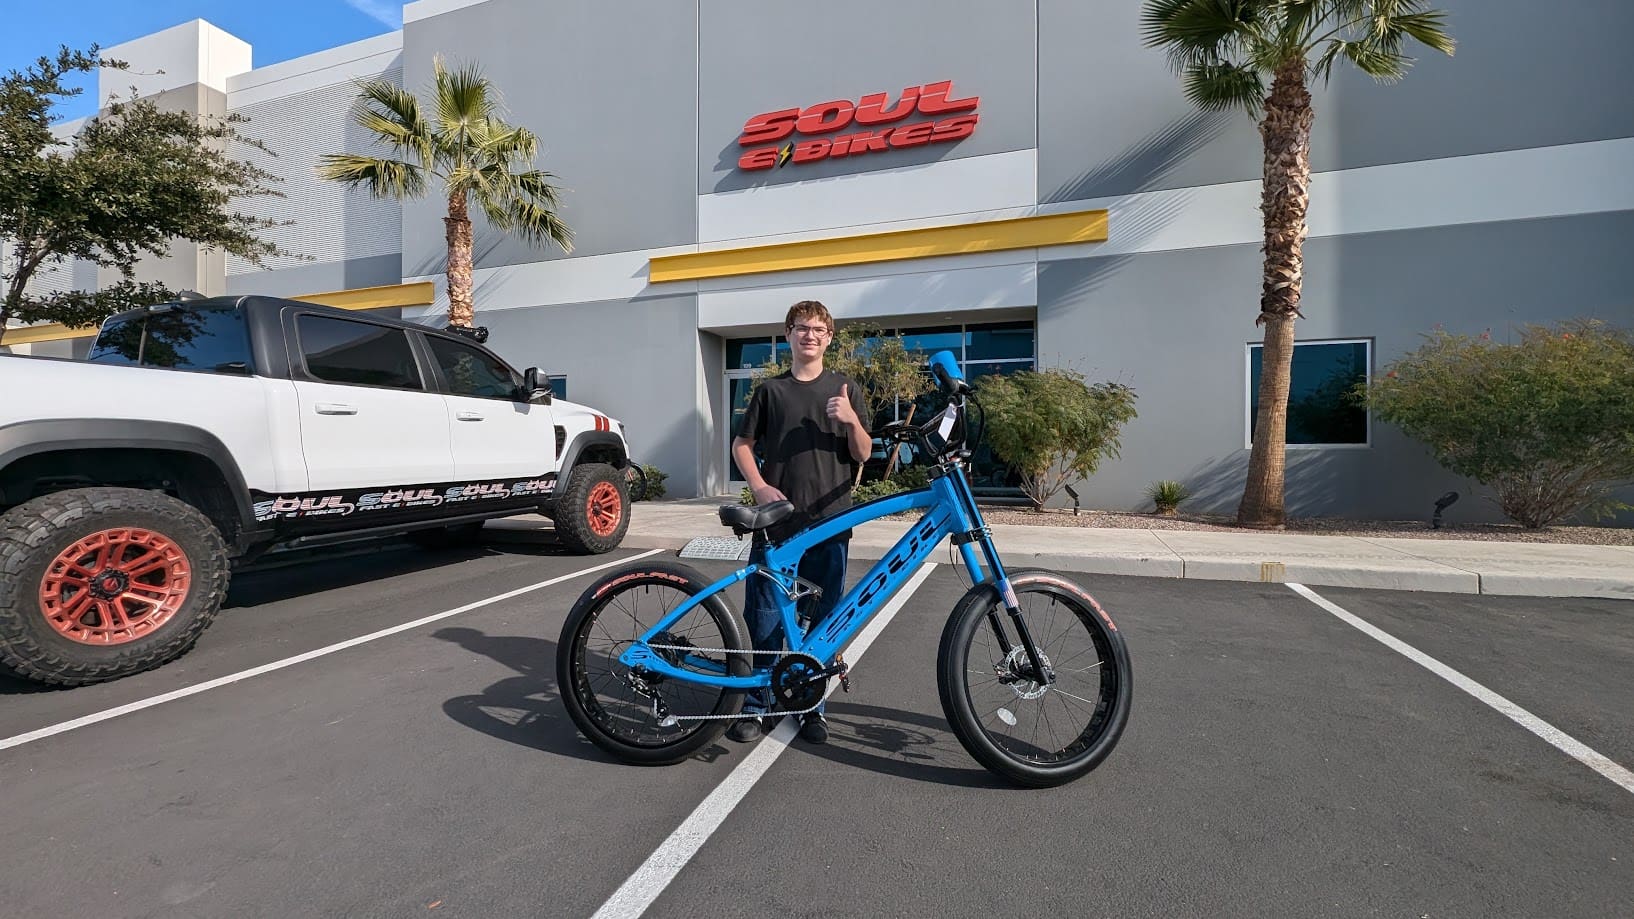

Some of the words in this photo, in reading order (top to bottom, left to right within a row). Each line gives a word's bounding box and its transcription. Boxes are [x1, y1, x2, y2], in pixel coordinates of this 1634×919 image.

[738, 80, 979, 146] SOUL
[356, 488, 443, 507] SOUL
[443, 483, 511, 499] SOUL
[253, 496, 354, 517] SOUL
[826, 516, 950, 643] SOUL
